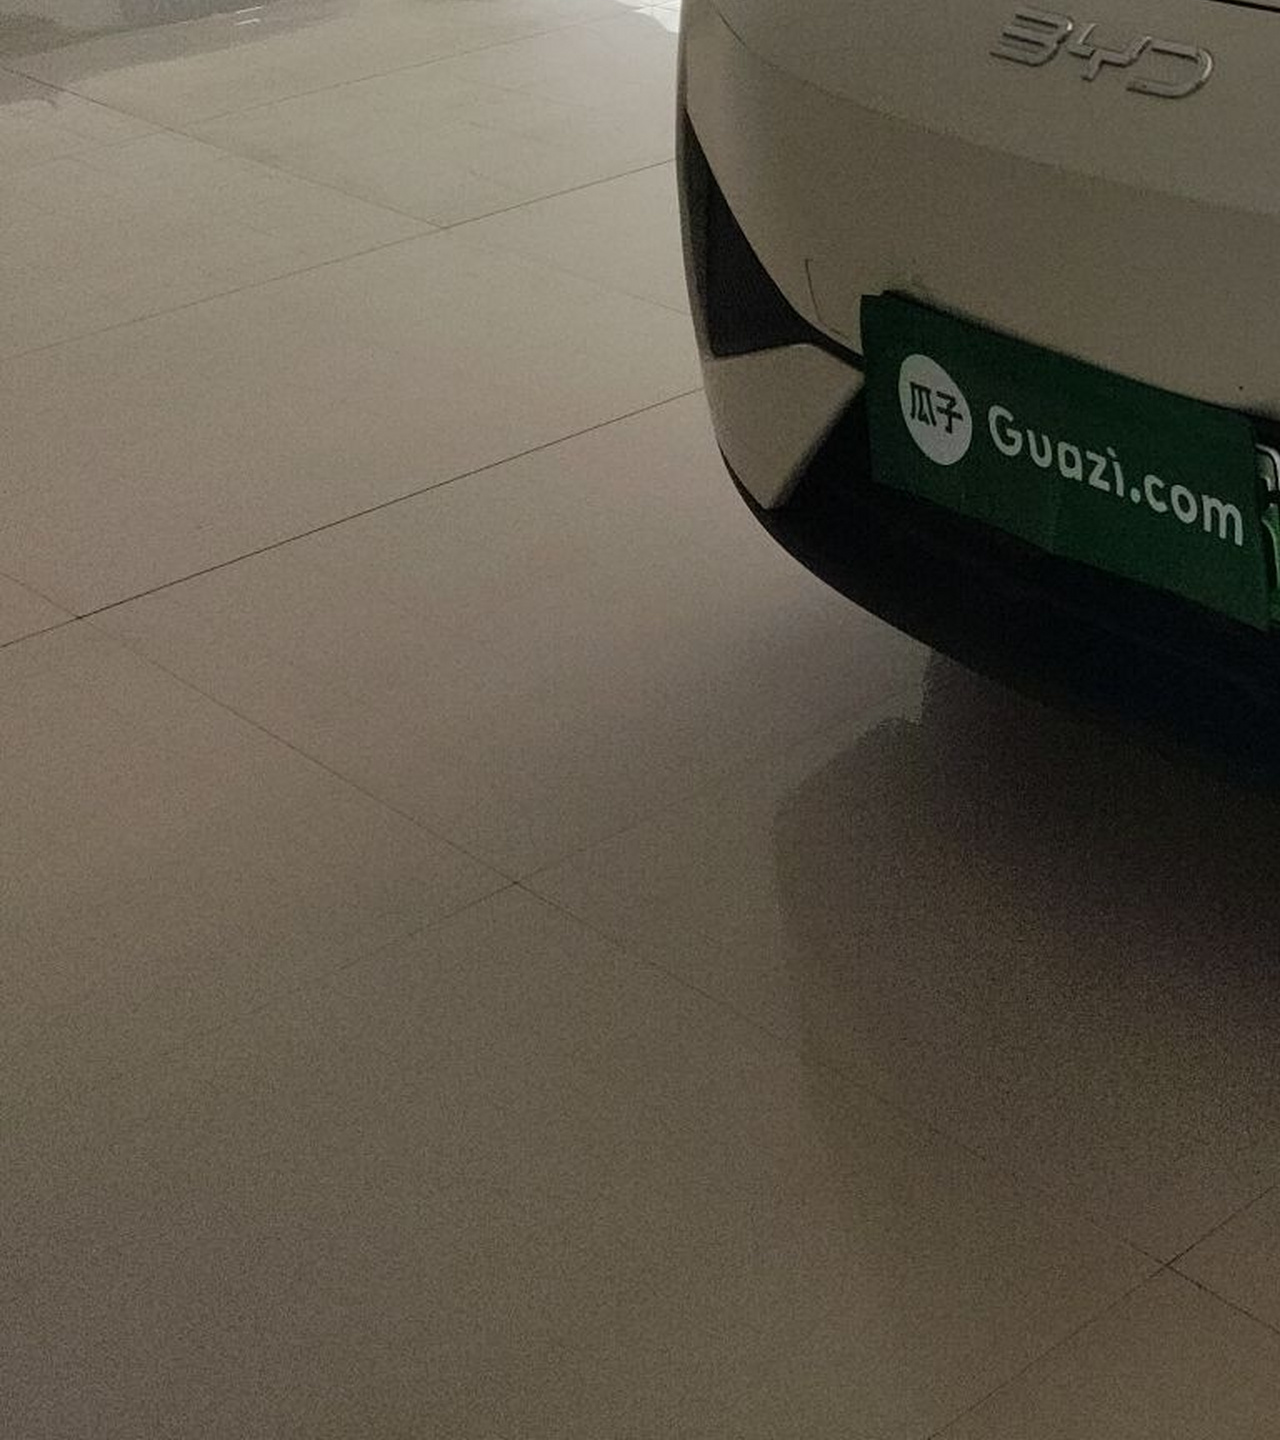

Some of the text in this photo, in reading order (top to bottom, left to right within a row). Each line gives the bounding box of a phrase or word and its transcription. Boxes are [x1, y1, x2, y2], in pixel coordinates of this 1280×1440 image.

[989, 5, 1215, 99] BYD
[909, 381, 1244, 547] 瓜子 Guazi.com
